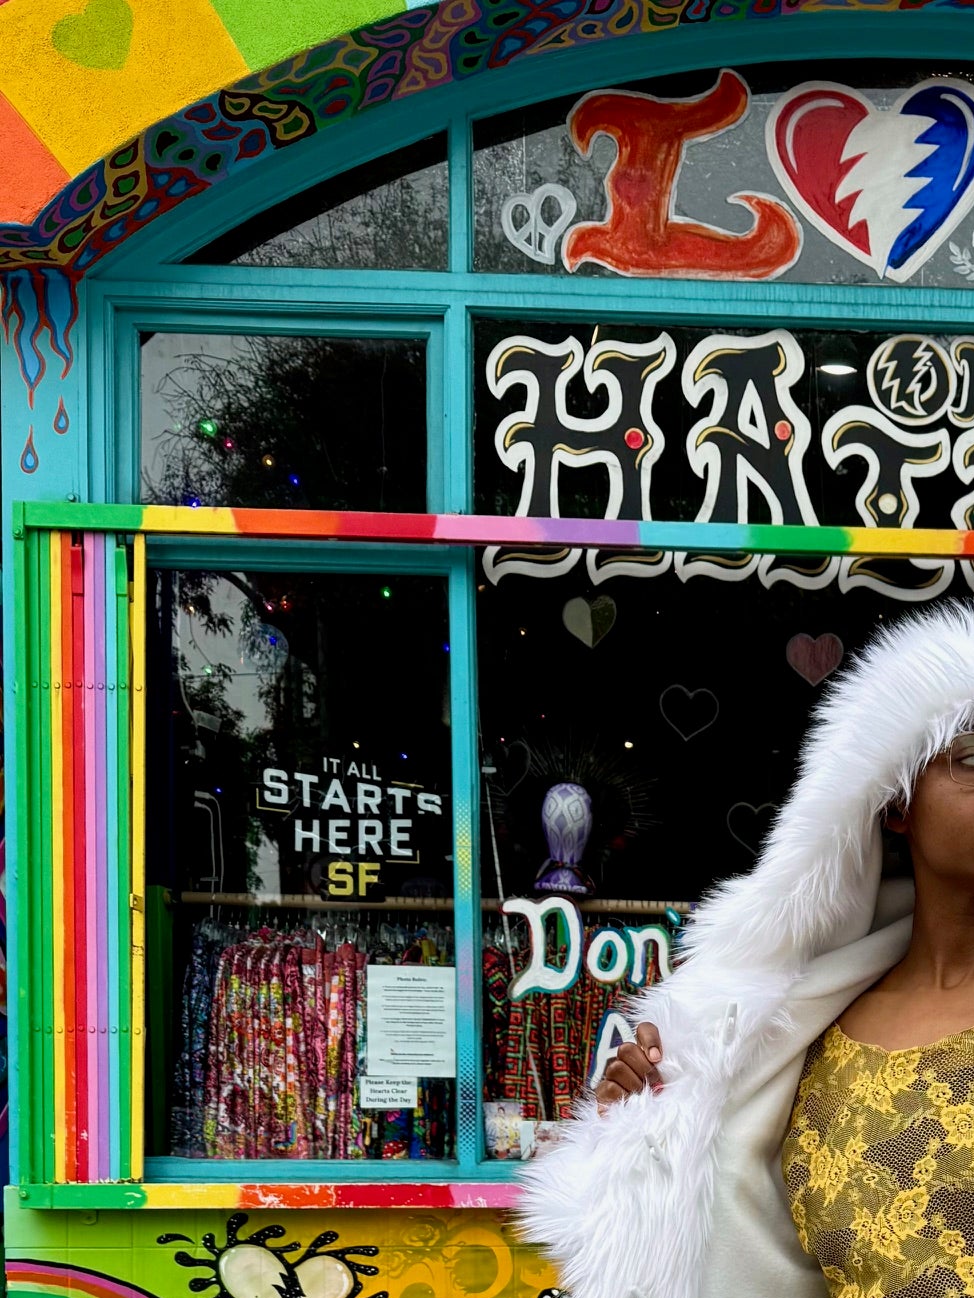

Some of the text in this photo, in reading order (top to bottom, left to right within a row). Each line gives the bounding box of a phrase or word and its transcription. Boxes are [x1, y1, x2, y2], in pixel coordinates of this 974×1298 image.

[322, 757, 382, 781] IT ALL
[263, 767, 443, 816] STARTS
[294, 819, 413, 857] HERE
[328, 861, 381, 897] SF
